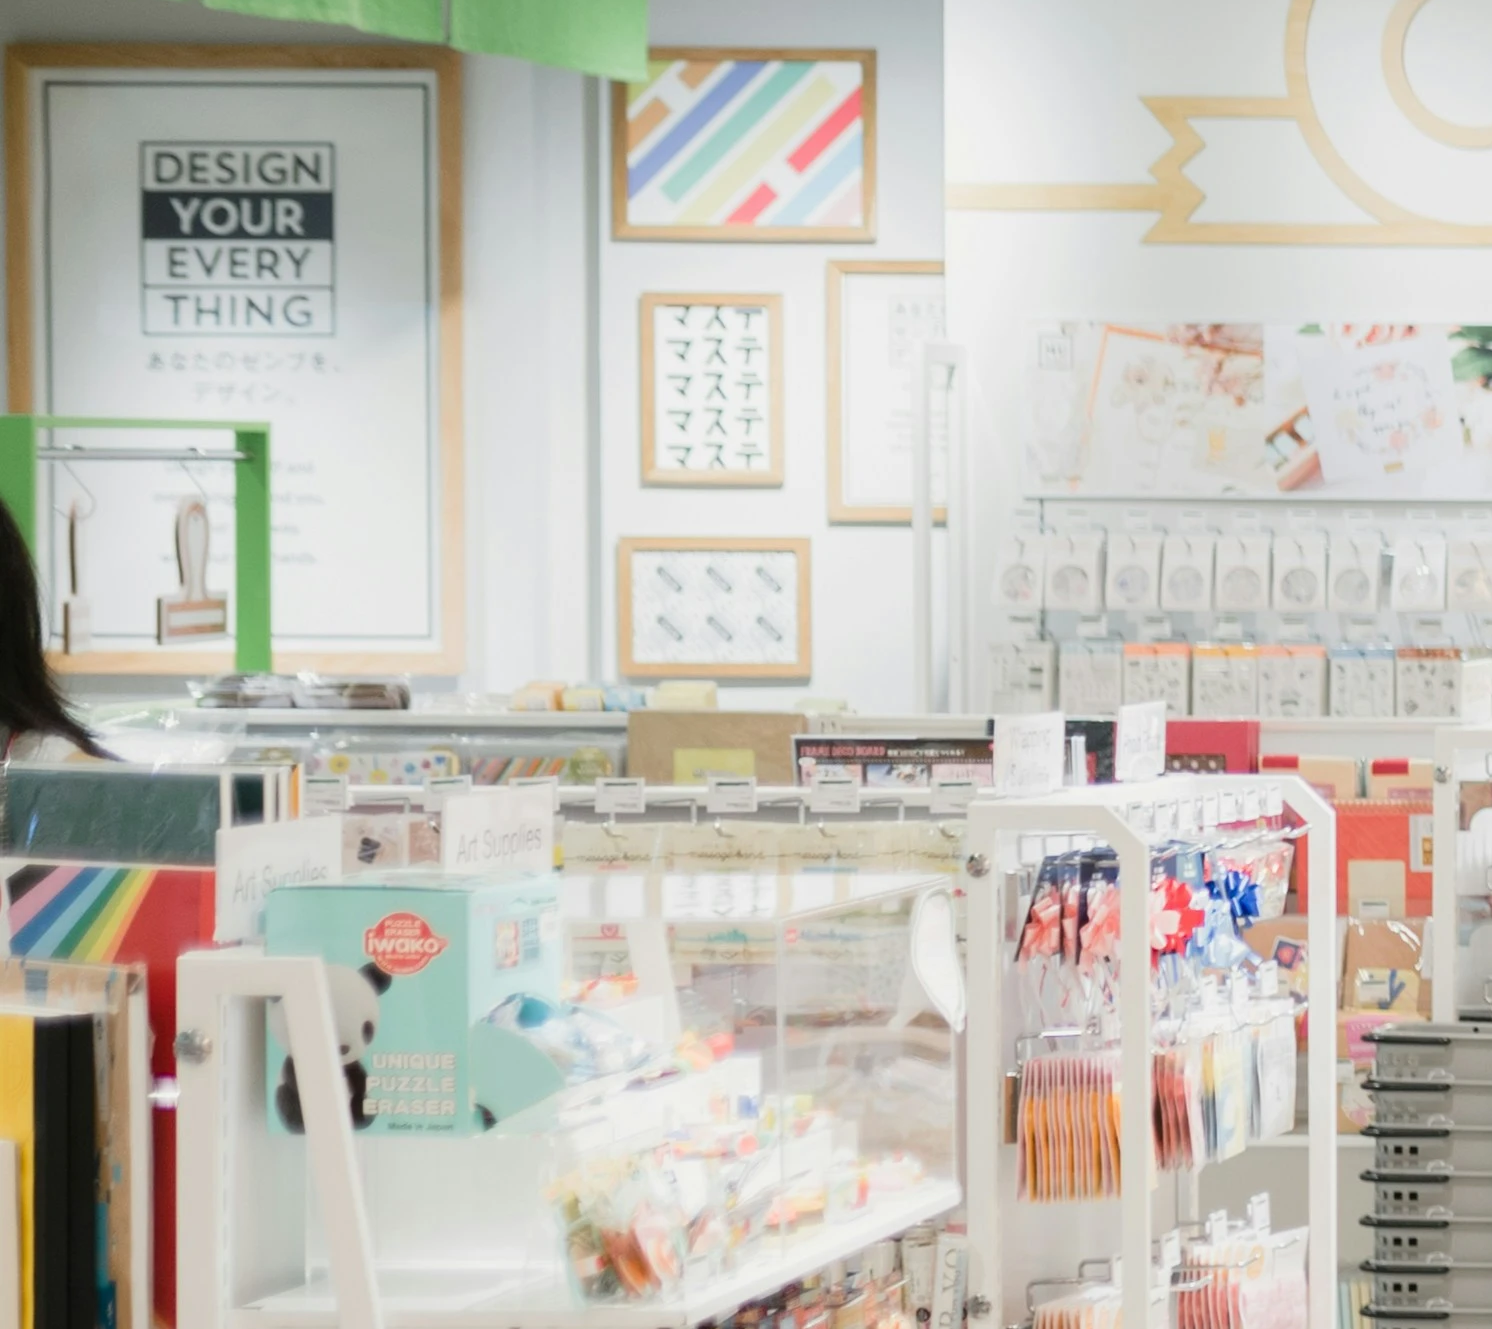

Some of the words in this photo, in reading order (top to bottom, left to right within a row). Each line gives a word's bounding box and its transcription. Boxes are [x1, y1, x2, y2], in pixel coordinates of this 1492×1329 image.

[153, 151, 322, 185] DESIGN
[168, 197, 306, 236] YOUR
[167, 246, 312, 280] EVERY
[162, 293, 313, 327] THING
[456, 835, 481, 864] Art
[482, 826, 543, 860] Supplies
[232, 873, 257, 903] Art
[367, 932, 440, 955] iwako
[372, 1053, 456, 1070] UNIQUE
[366, 1076, 456, 1093] PUZZLE
[362, 1099, 456, 1116] ERASER
[387, 1122, 413, 1132] Made
[426, 1122, 455, 1133] Japan
